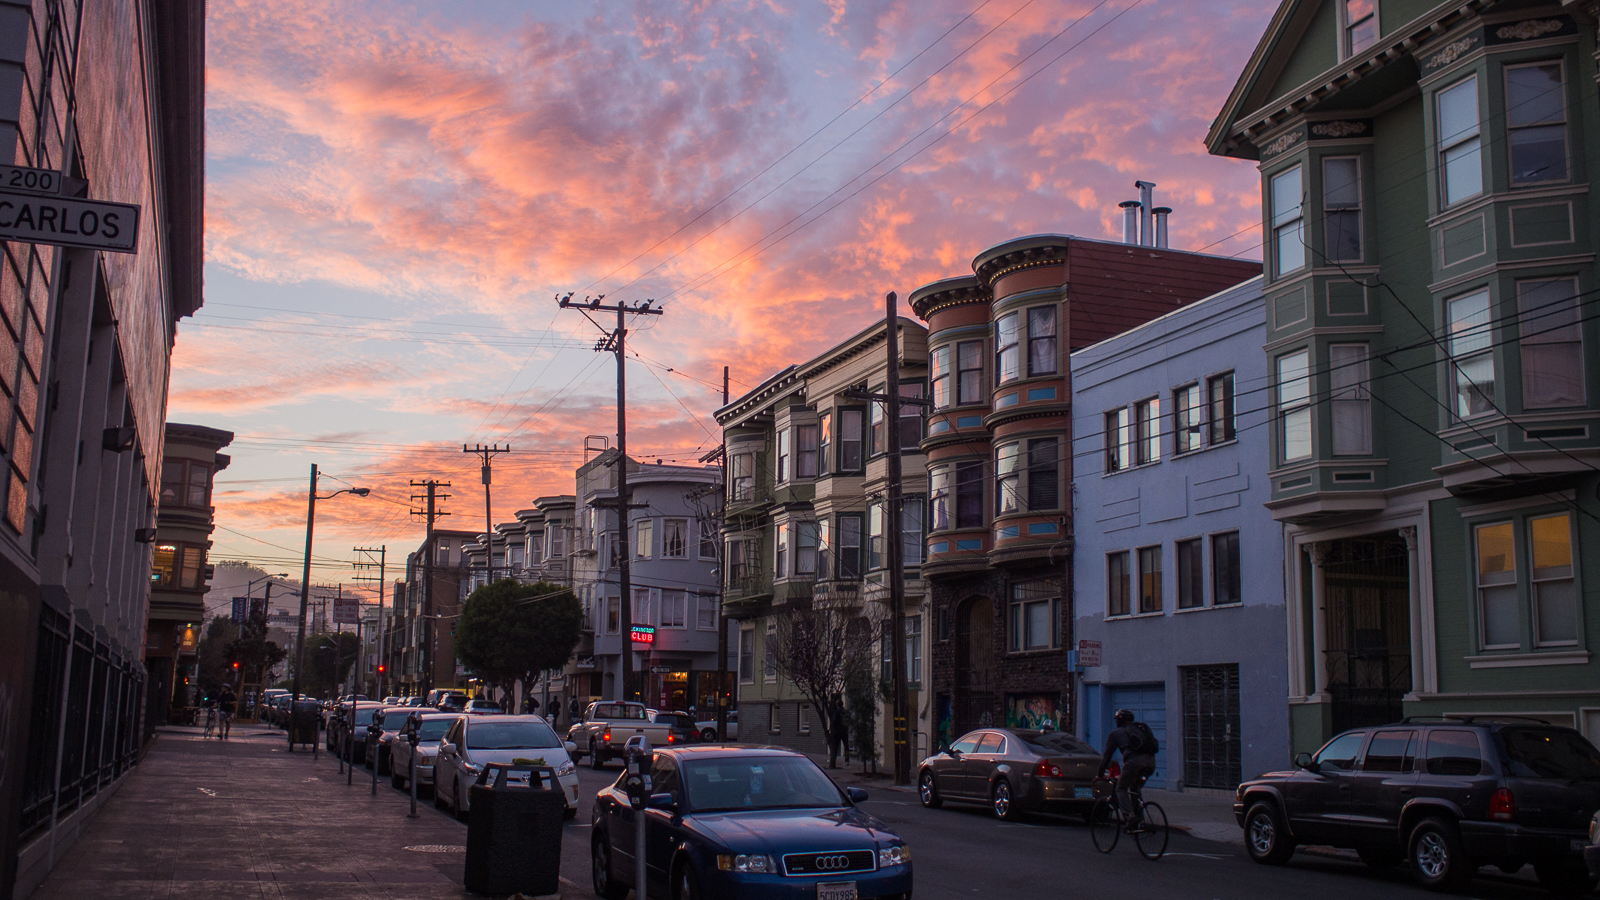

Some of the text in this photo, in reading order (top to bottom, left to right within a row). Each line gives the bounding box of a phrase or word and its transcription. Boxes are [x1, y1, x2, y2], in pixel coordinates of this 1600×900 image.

[9, 170, 52, 190] 200
[0, 201, 119, 239] CARLOS
[631, 632, 653, 642] CLUB
[820, 890, 855, 900] 5CDY985
